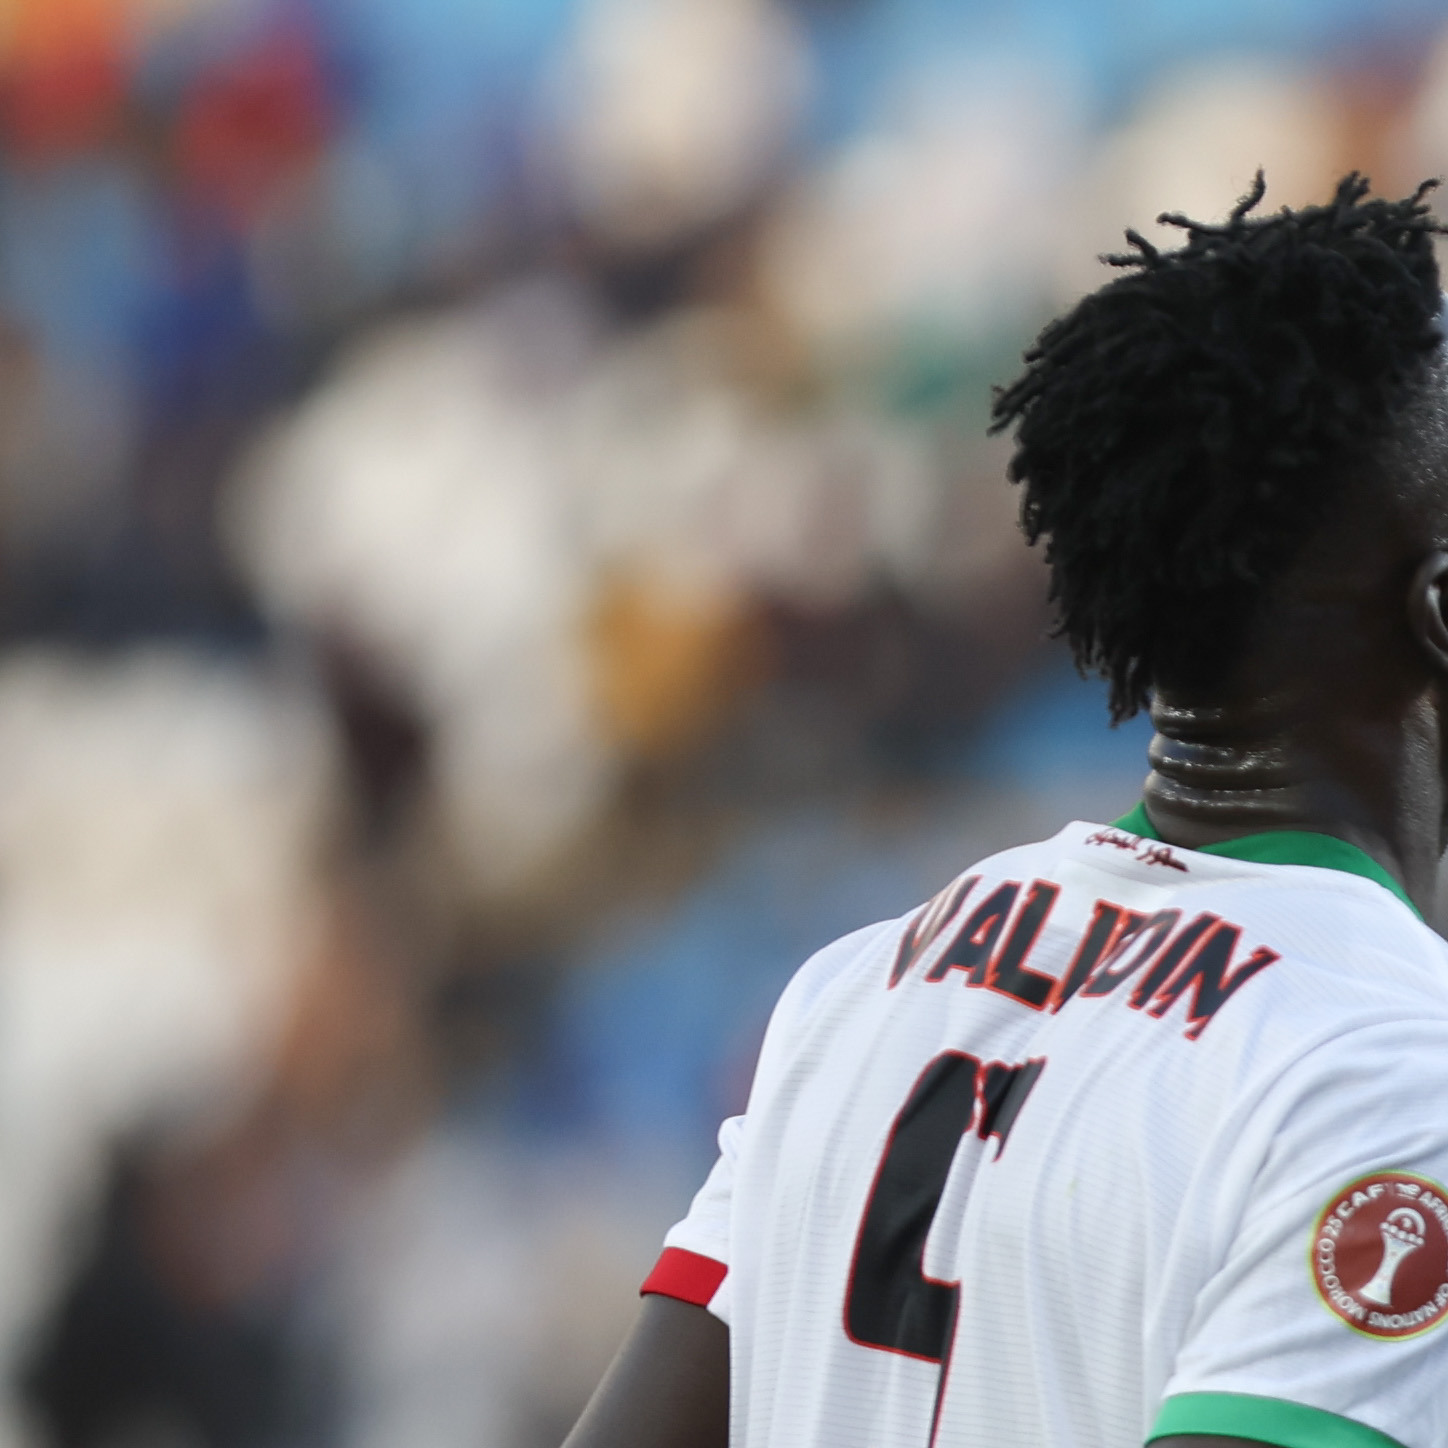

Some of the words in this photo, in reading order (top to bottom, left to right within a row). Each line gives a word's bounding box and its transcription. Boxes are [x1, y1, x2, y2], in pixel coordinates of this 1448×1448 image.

[1336, 1183, 1385, 1219] CAF
[1318, 1238, 1368, 1320] MOROCCO
[1368, 1301, 1439, 1329] NATIONS
